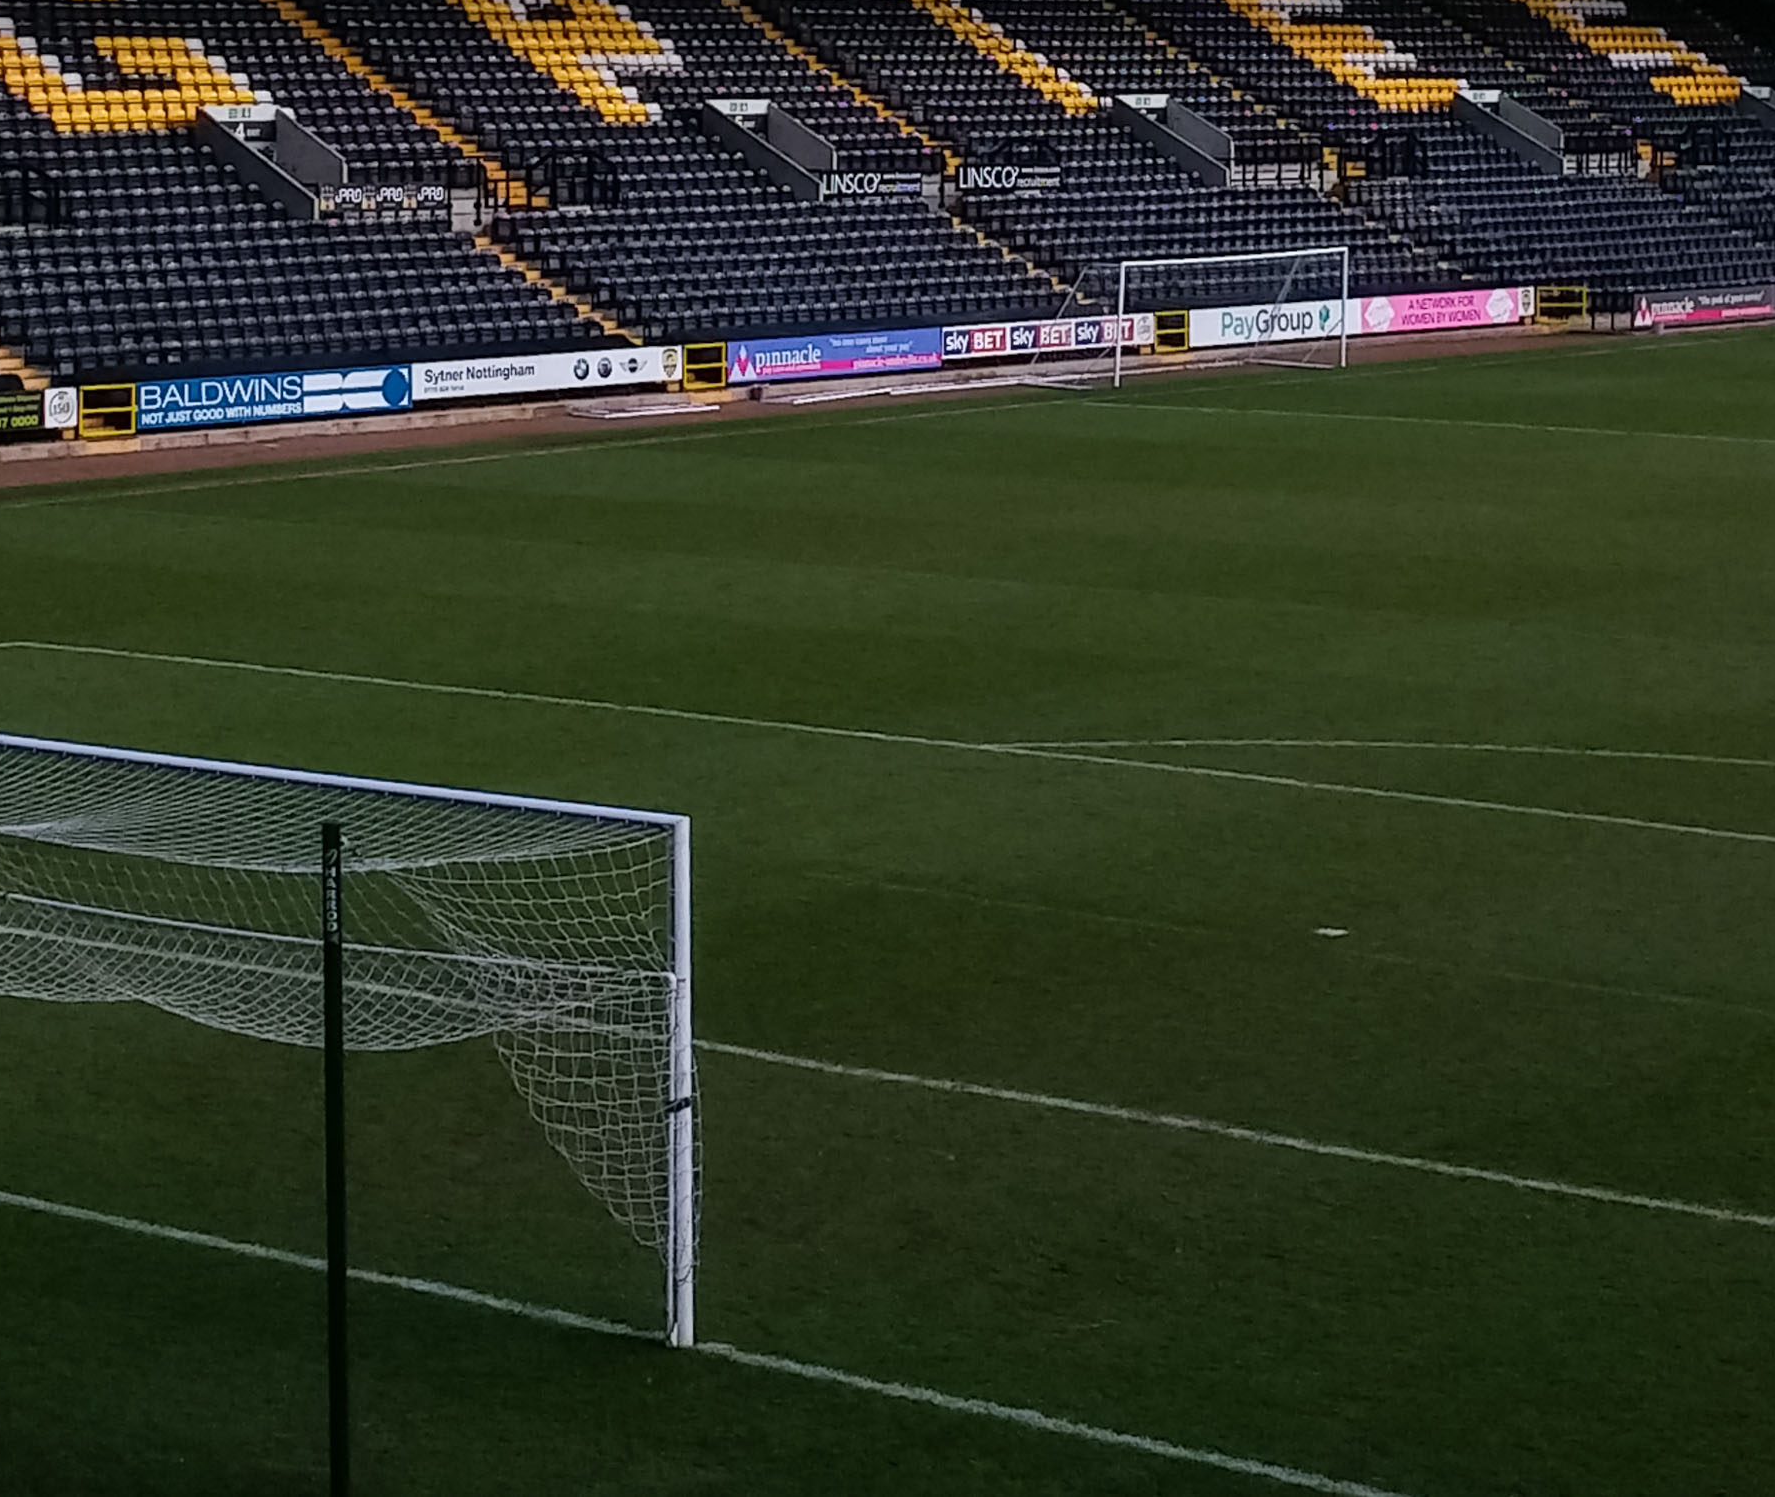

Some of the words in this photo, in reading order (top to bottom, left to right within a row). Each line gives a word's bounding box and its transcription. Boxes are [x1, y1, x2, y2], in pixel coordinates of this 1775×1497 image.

[1416, 297, 1455, 309] NETWORK
[1458, 295, 1474, 307] FOR
[1221, 311, 1313, 339] PayGroup
[1401, 313, 1435, 325] WOMEN
[1448, 309, 1481, 321] WOMEN
[946, 337, 969, 352] sky
[974, 330, 1003, 349] BET
[1012, 329, 1035, 346] sky
[1040, 325, 1069, 344] BET
[1077, 323, 1100, 343] sky
[755, 344, 821, 370] pinnacle
[424, 368, 463, 385] Sytner
[466, 363, 535, 381] Nottingham
[140, 376, 302, 410] BALDWINS
[141, 412, 163, 425] NOT
[165, 409, 191, 423] JUST
[193, 407, 223, 420] GOOD
[225, 405, 251, 418] WITH
[253, 402, 302, 415] NUMBERS
